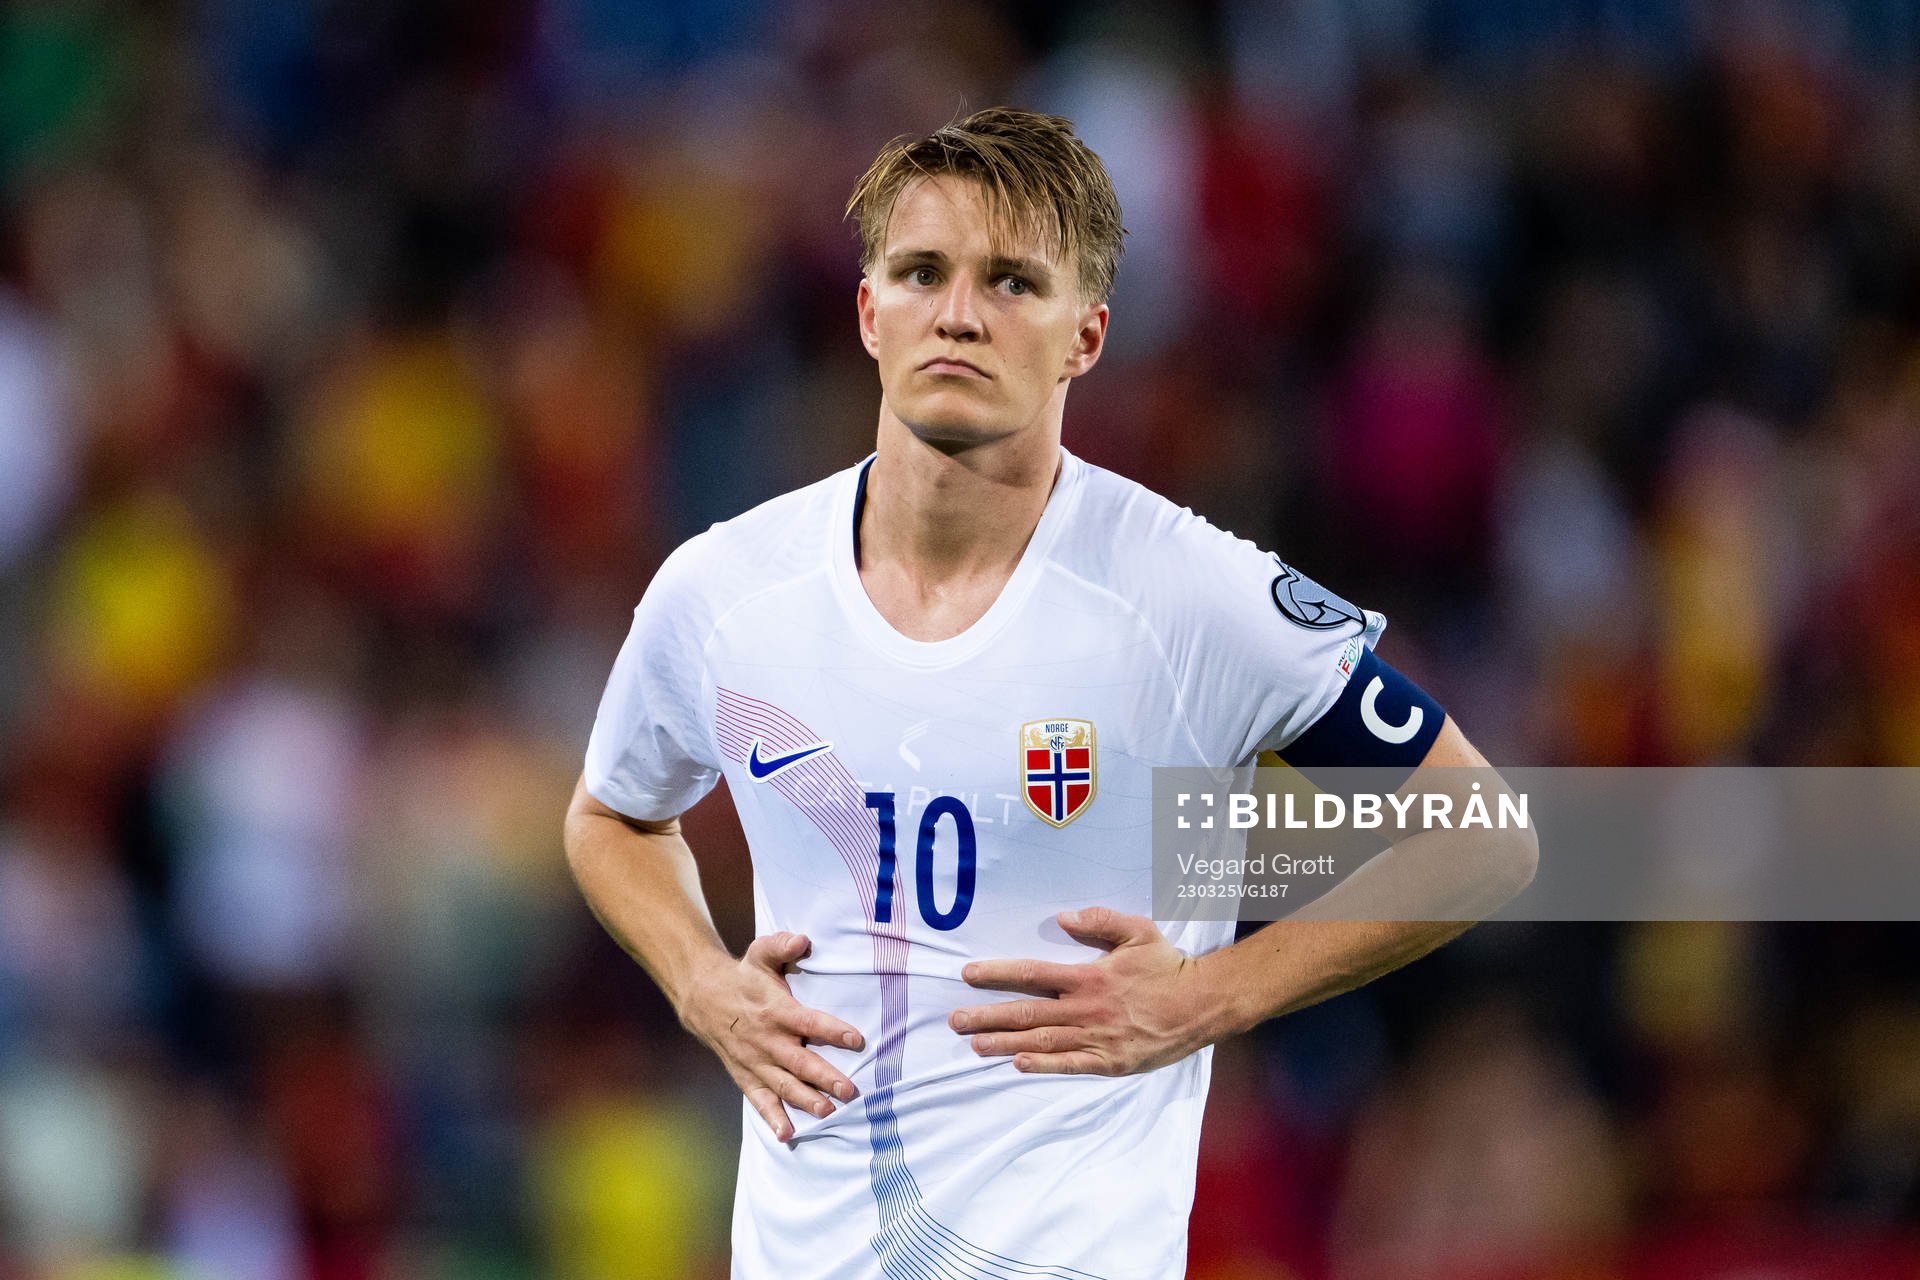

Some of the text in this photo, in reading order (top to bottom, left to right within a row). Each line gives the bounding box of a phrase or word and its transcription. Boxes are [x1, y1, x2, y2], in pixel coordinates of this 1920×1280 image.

[1045, 723, 1069, 733] NORGE
[1360, 675, 1424, 744] C
[795, 774, 1020, 825] CATPLT
[865, 792, 977, 931] 10
